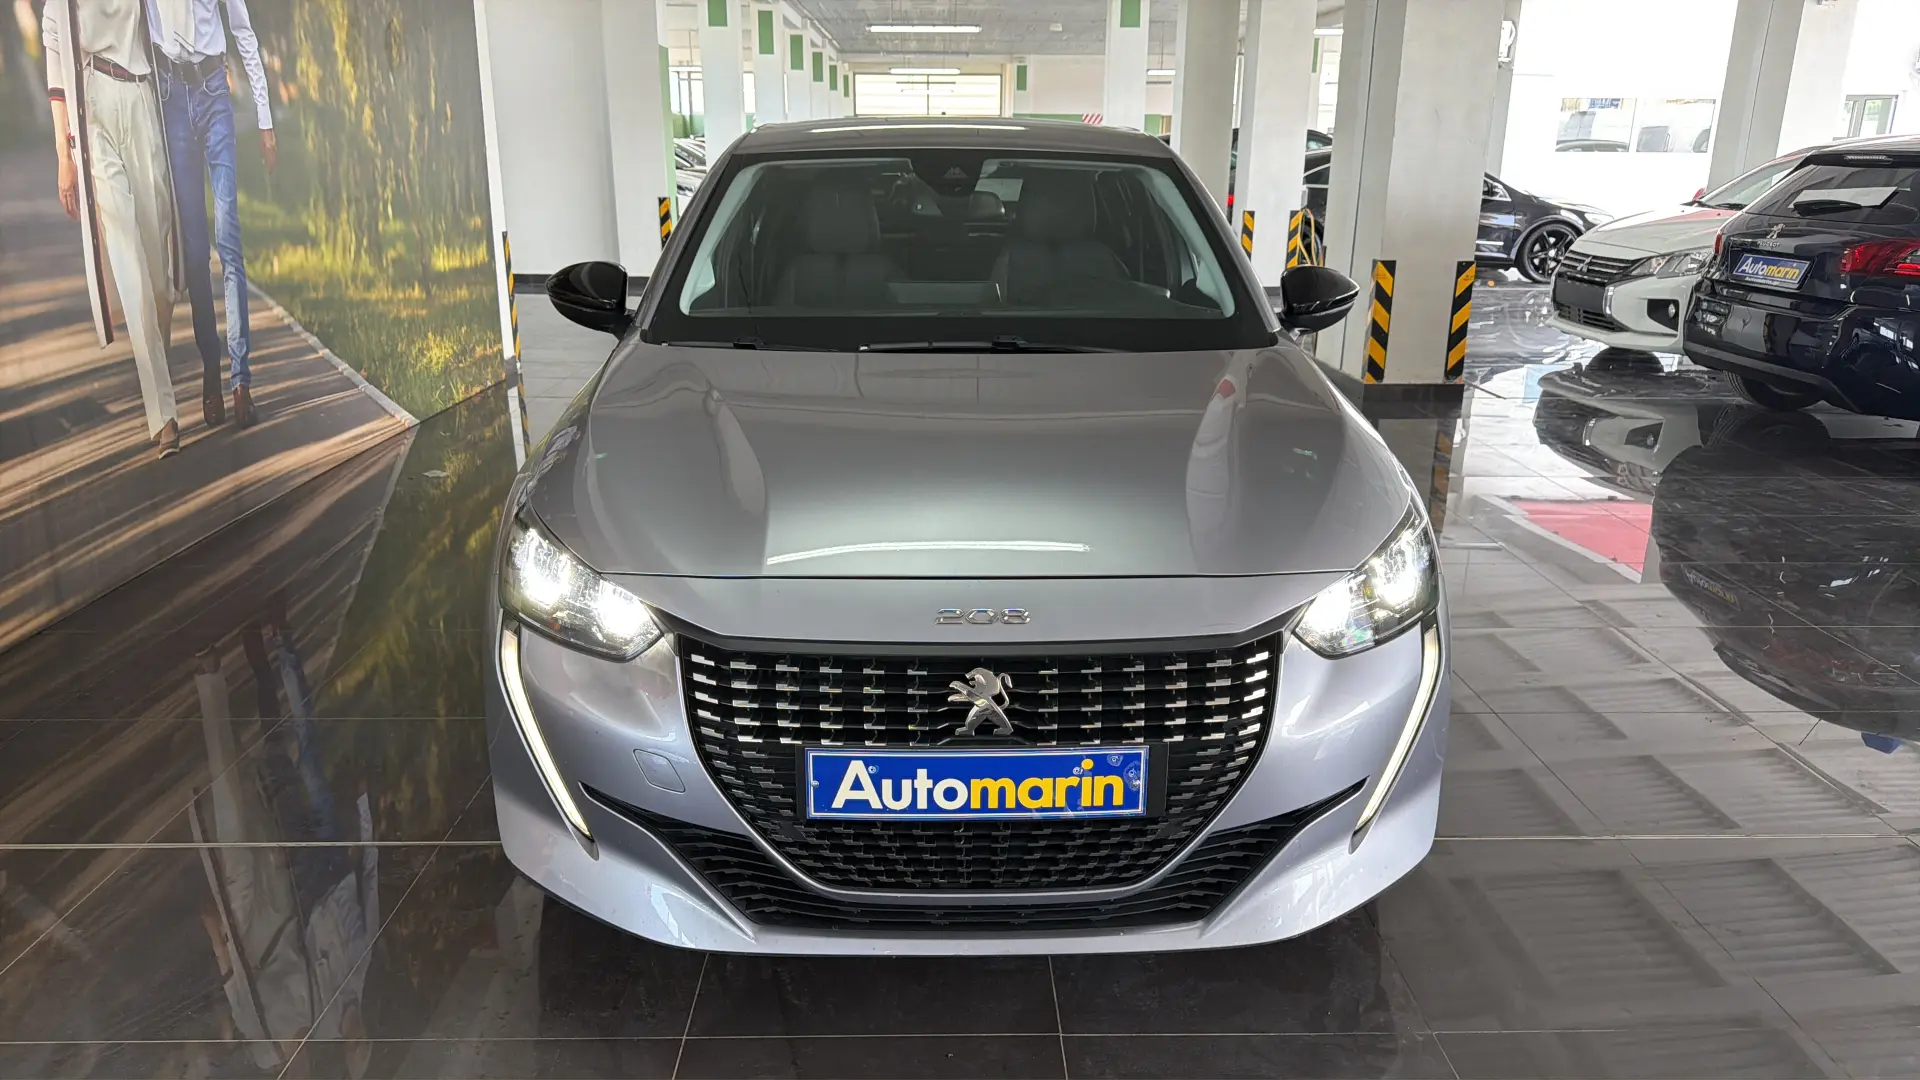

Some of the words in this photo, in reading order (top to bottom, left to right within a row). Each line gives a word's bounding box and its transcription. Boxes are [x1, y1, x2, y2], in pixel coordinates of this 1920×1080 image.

[1738, 257, 1800, 279] Automarin
[935, 608, 1031, 625] 208
[831, 758, 1124, 810] Automarin
